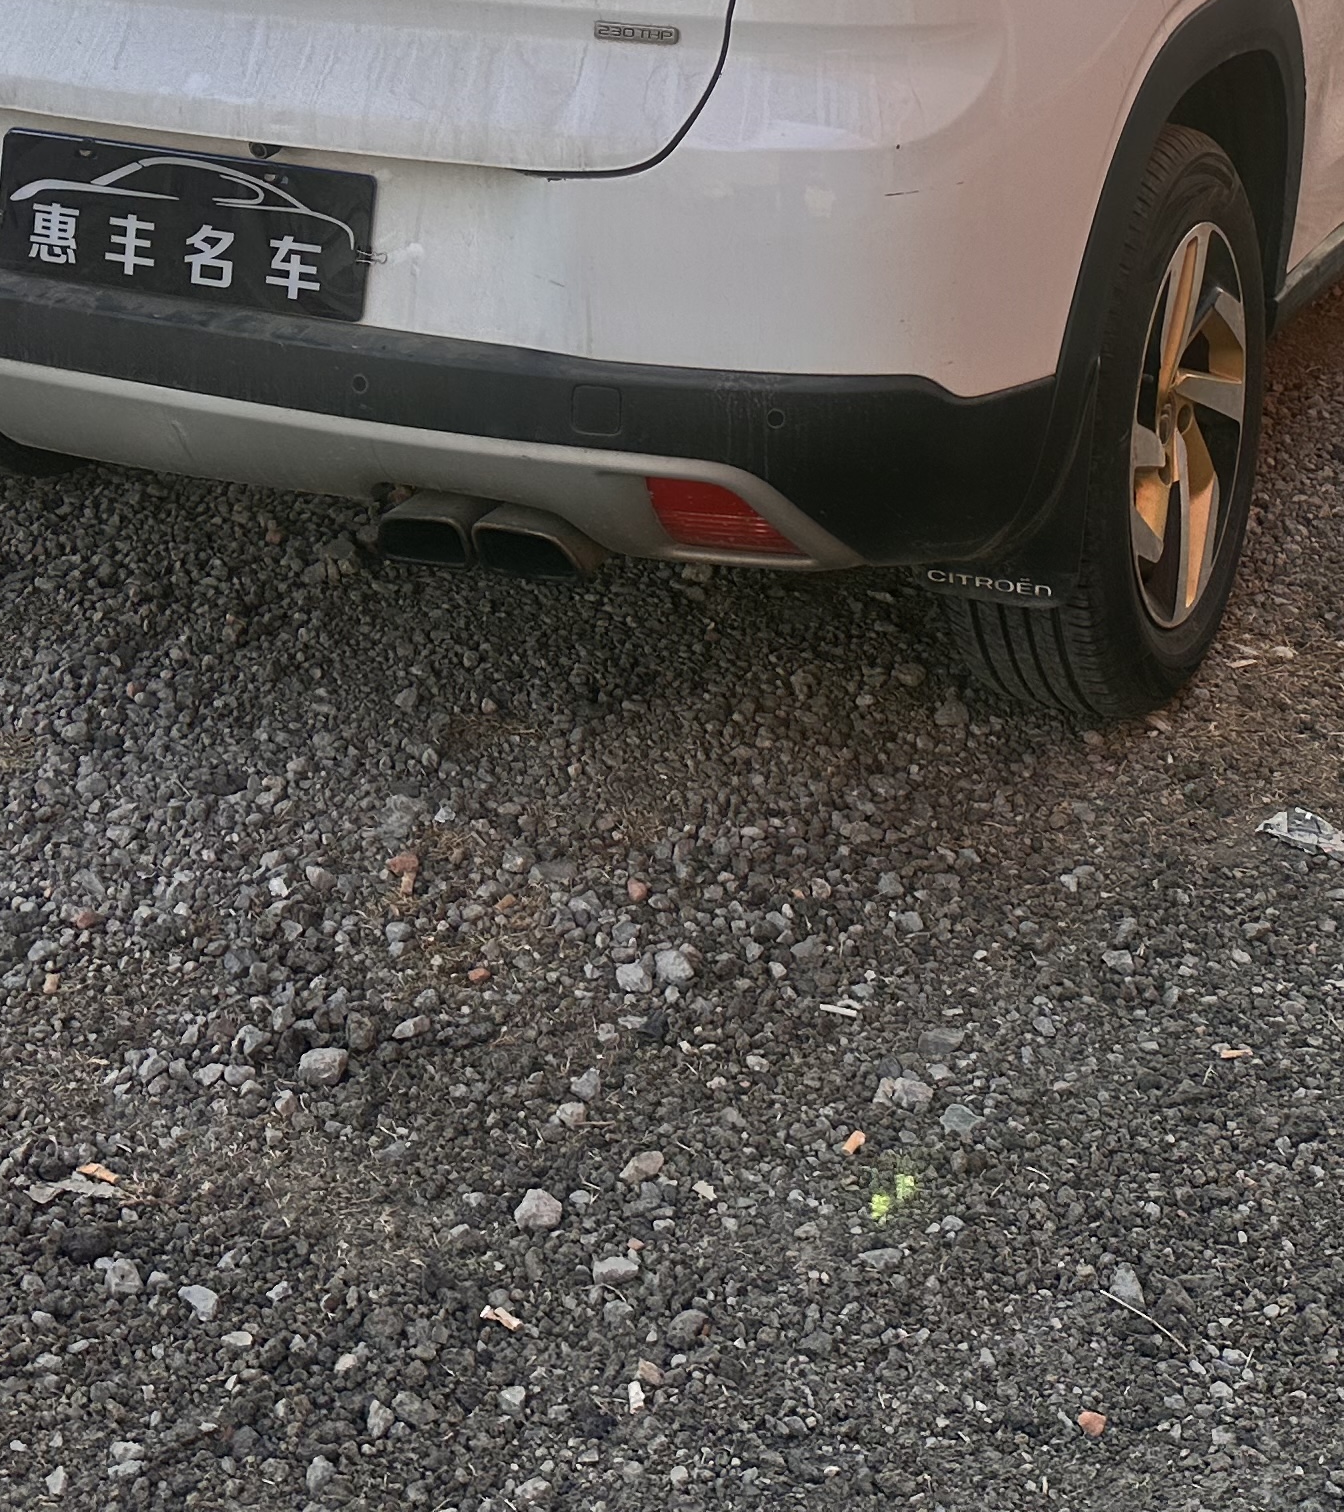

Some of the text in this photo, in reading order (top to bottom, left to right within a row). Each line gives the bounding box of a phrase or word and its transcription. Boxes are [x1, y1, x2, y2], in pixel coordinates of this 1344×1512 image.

[597, 24, 674, 41] 230 THP
[28, 202, 323, 300] 惠丰名车
